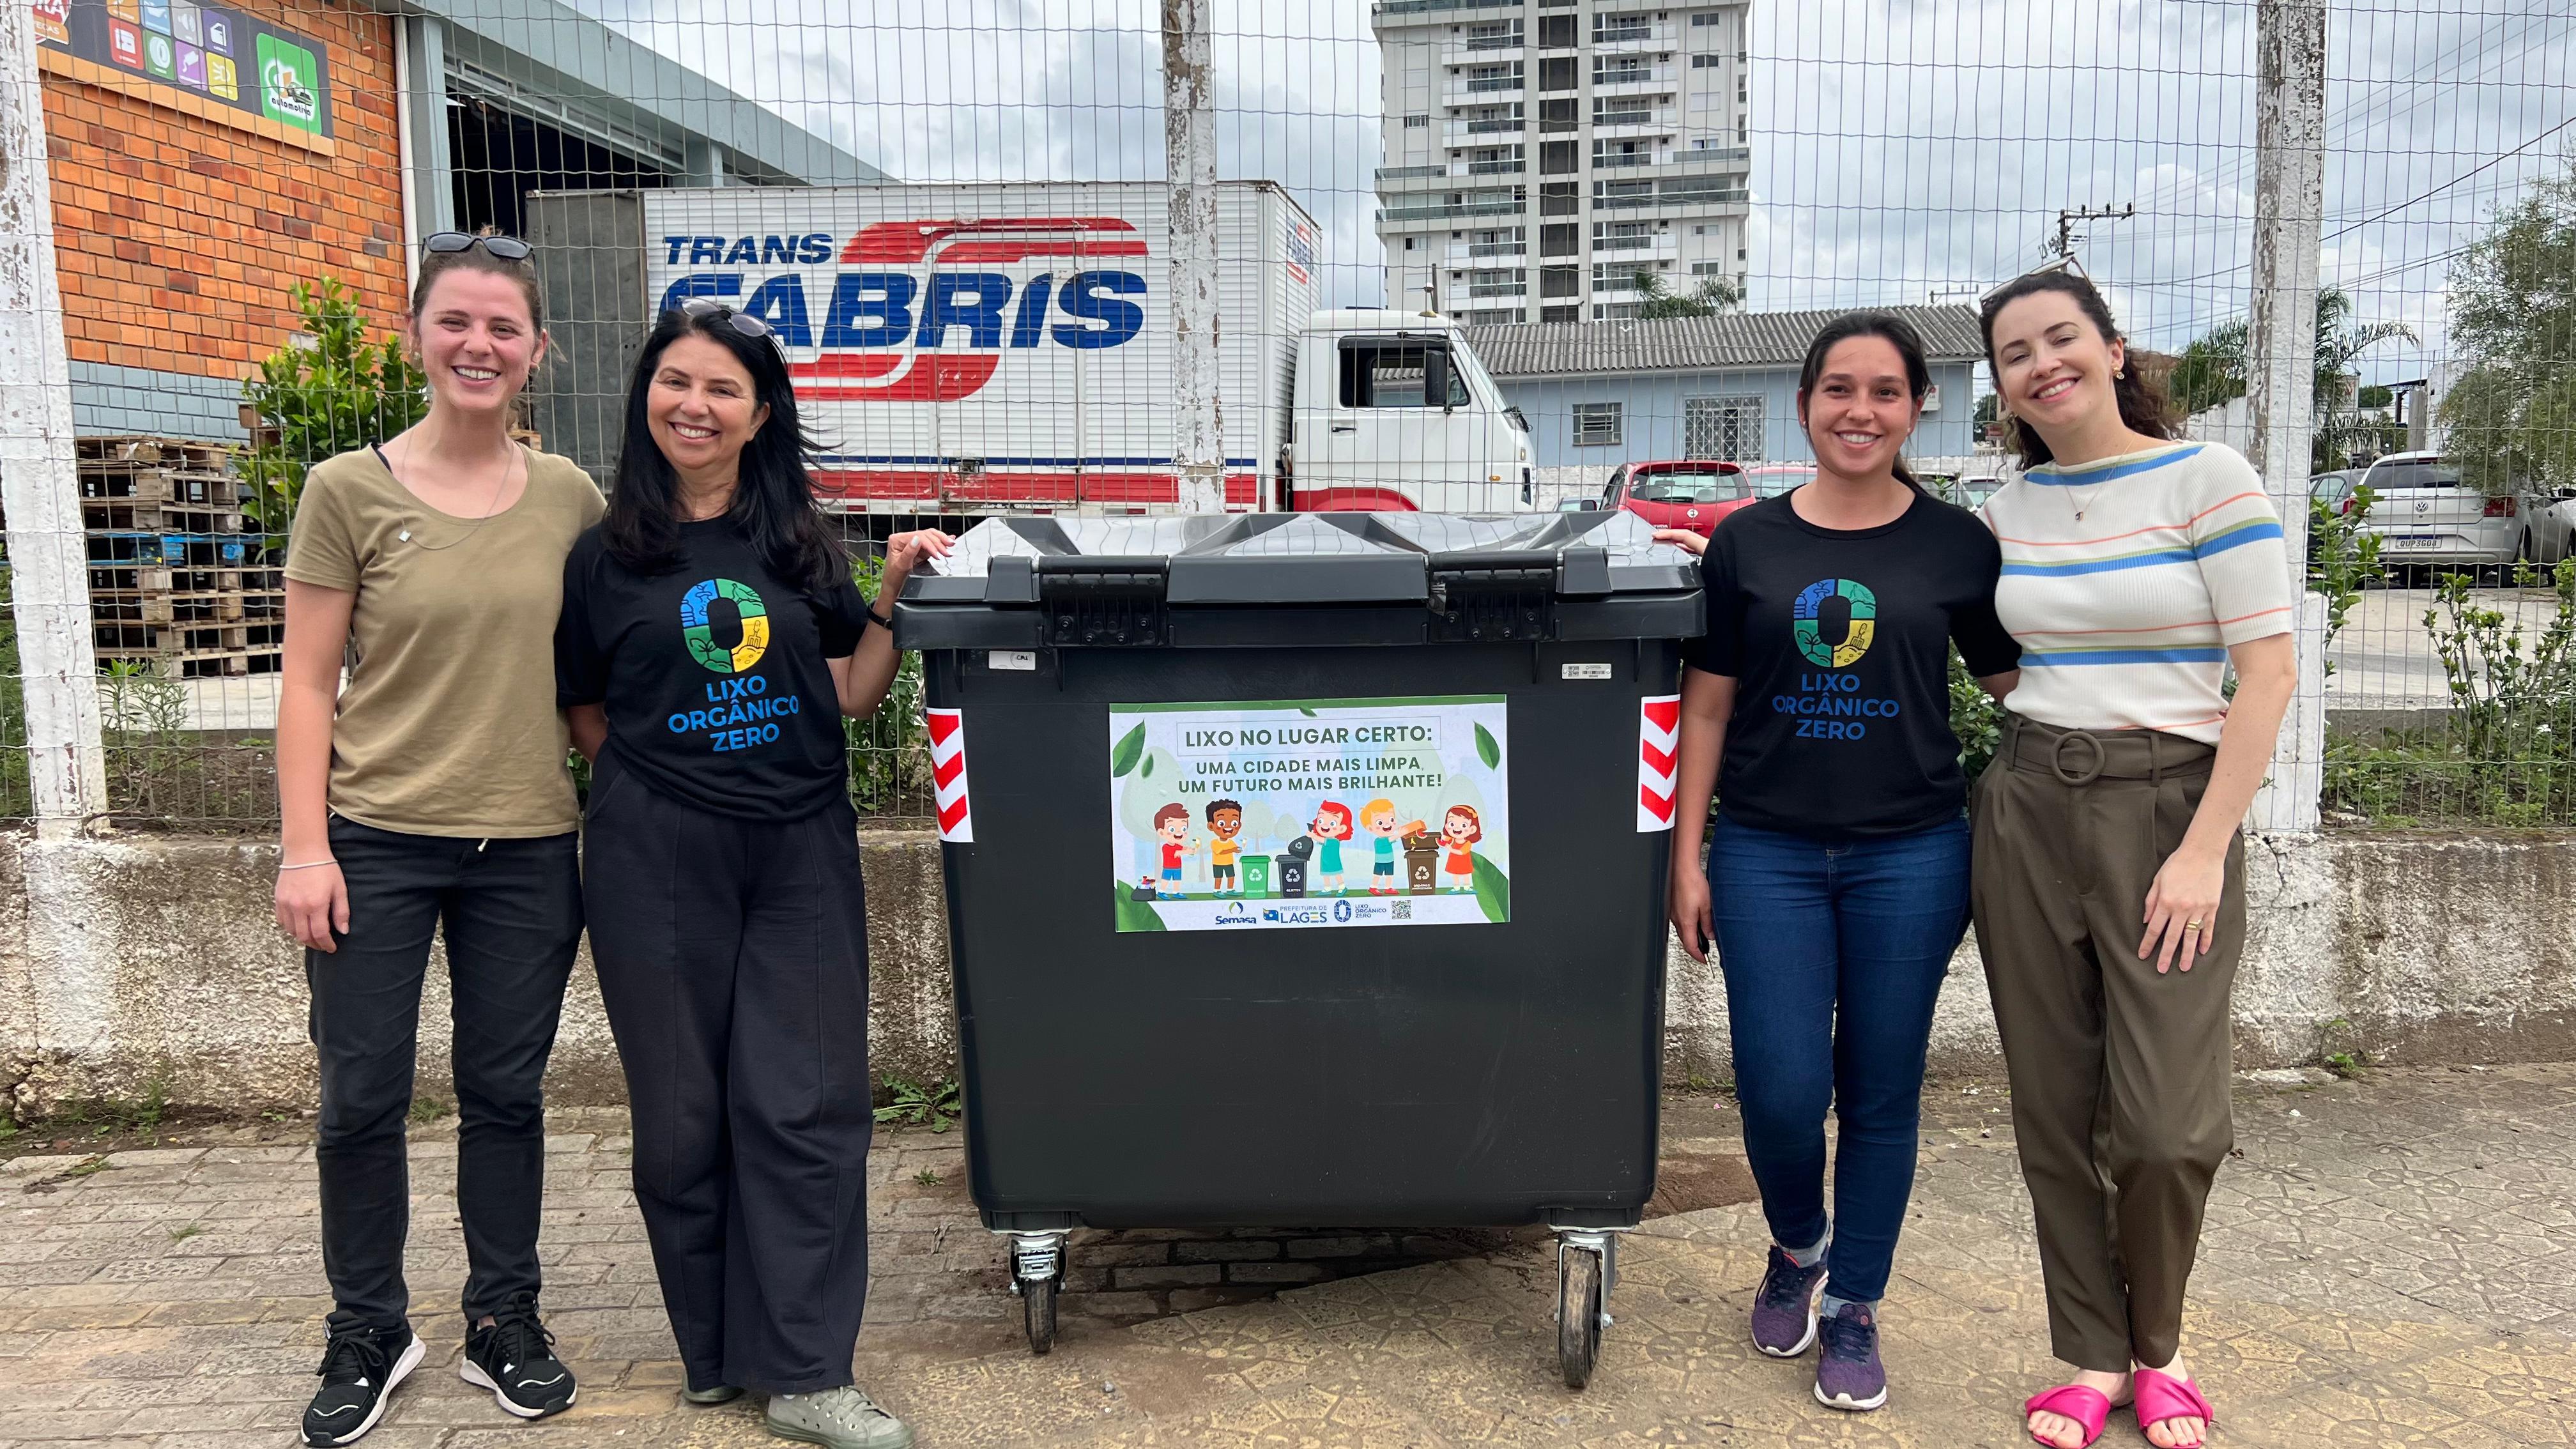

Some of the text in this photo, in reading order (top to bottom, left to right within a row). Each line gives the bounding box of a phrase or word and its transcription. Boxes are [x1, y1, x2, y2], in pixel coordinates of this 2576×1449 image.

[662, 233, 834, 265] TRANS
[706, 675, 767, 702] LIXO
[1802, 673, 1860, 692] LIXO
[668, 695, 799, 733] ORGÂNICO
[1772, 692, 1899, 717] ORGÂNICO
[710, 723, 779, 752] ZERO
[1186, 726, 1431, 747] LIXO NO LUGAR CERTO:
[1796, 719, 1866, 740] ZERO
[1197, 756, 1423, 774] UMA CIDADE MAIS LIMPA,
[1179, 774, 1441, 793] UM FUTURO MAIS BRILHANTE!
[1215, 916, 1257, 924] Semasa
[1280, 912, 1327, 924] LAGES
